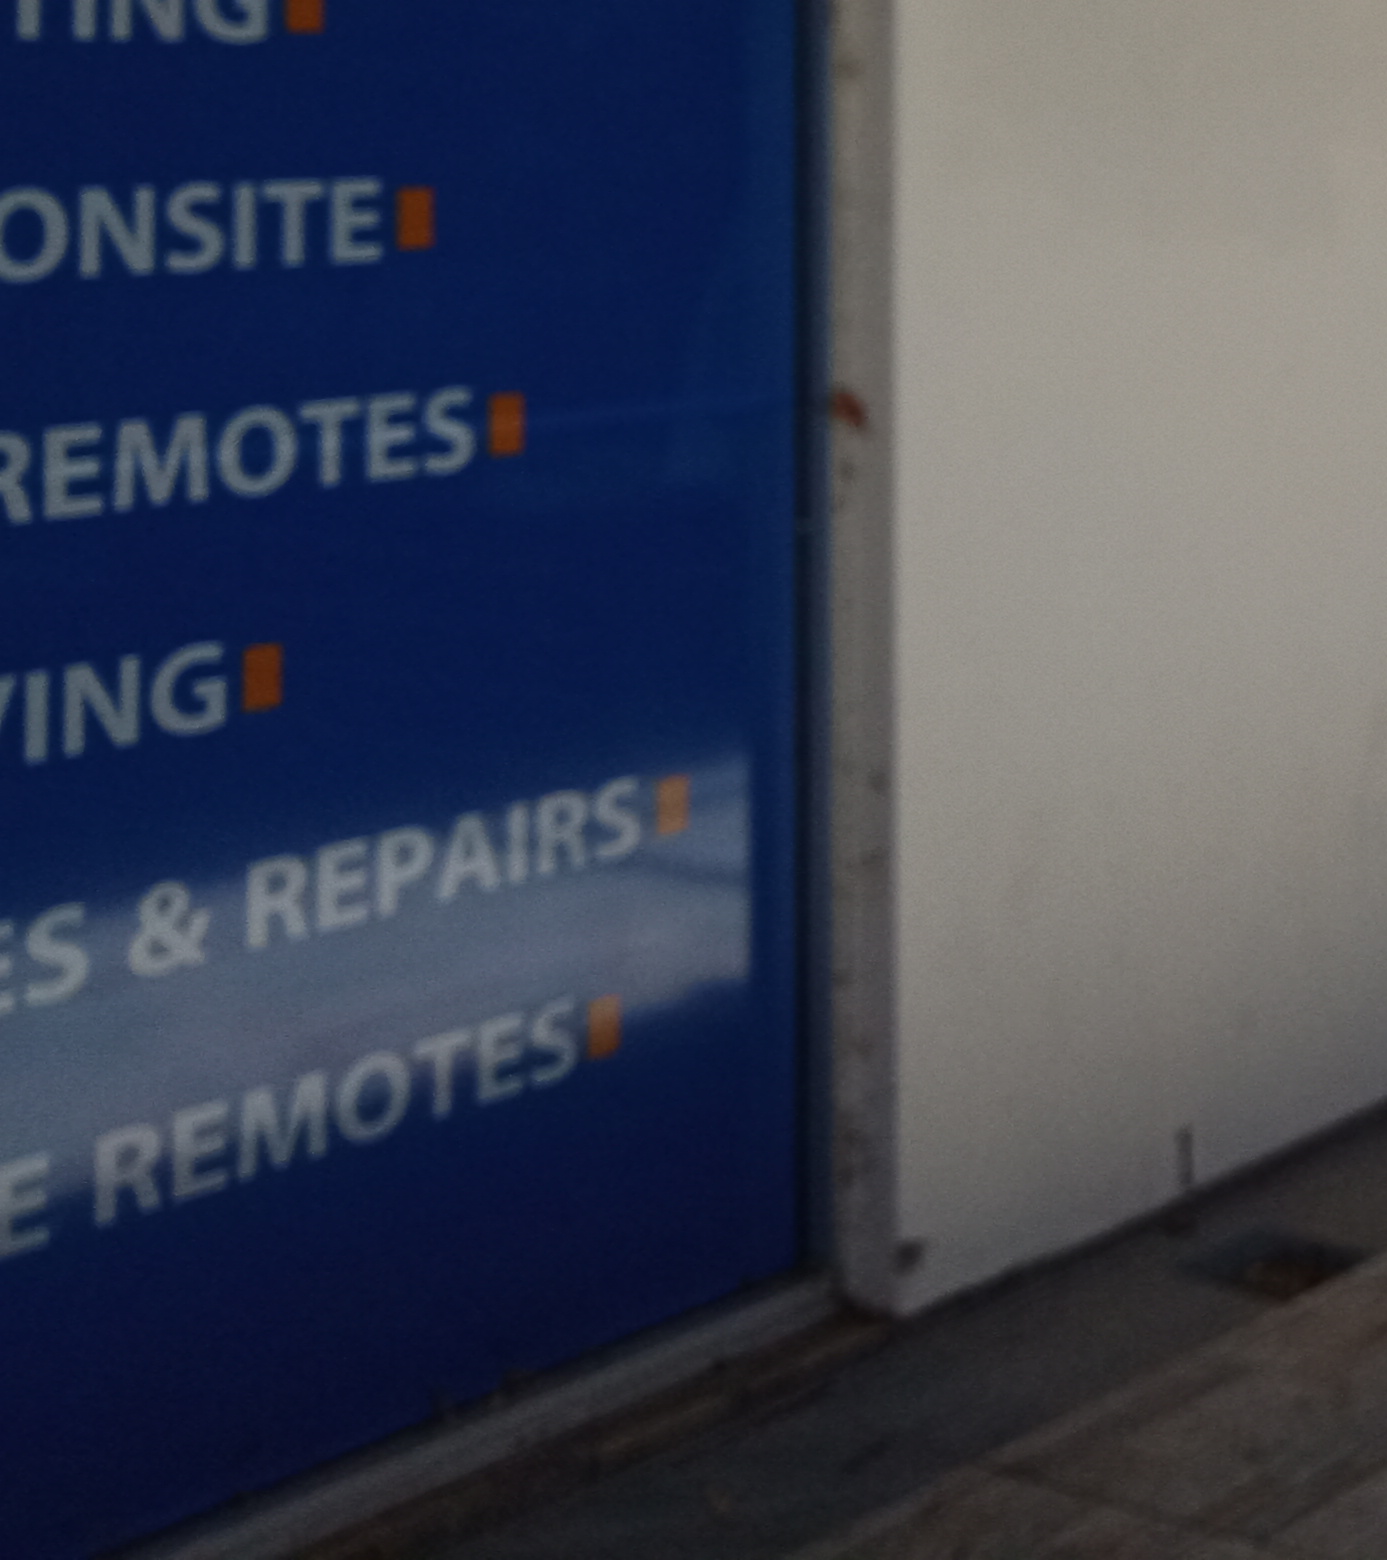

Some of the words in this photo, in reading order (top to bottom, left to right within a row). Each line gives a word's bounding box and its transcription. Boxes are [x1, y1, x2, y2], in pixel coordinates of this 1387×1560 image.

[0, 176, 385, 284] ONSITE
[0, 640, 229, 764] ING
[127, 878, 211, 978] &
[245, 775, 642, 950] REPAIRS
[93, 996, 580, 1228] REMOTES
